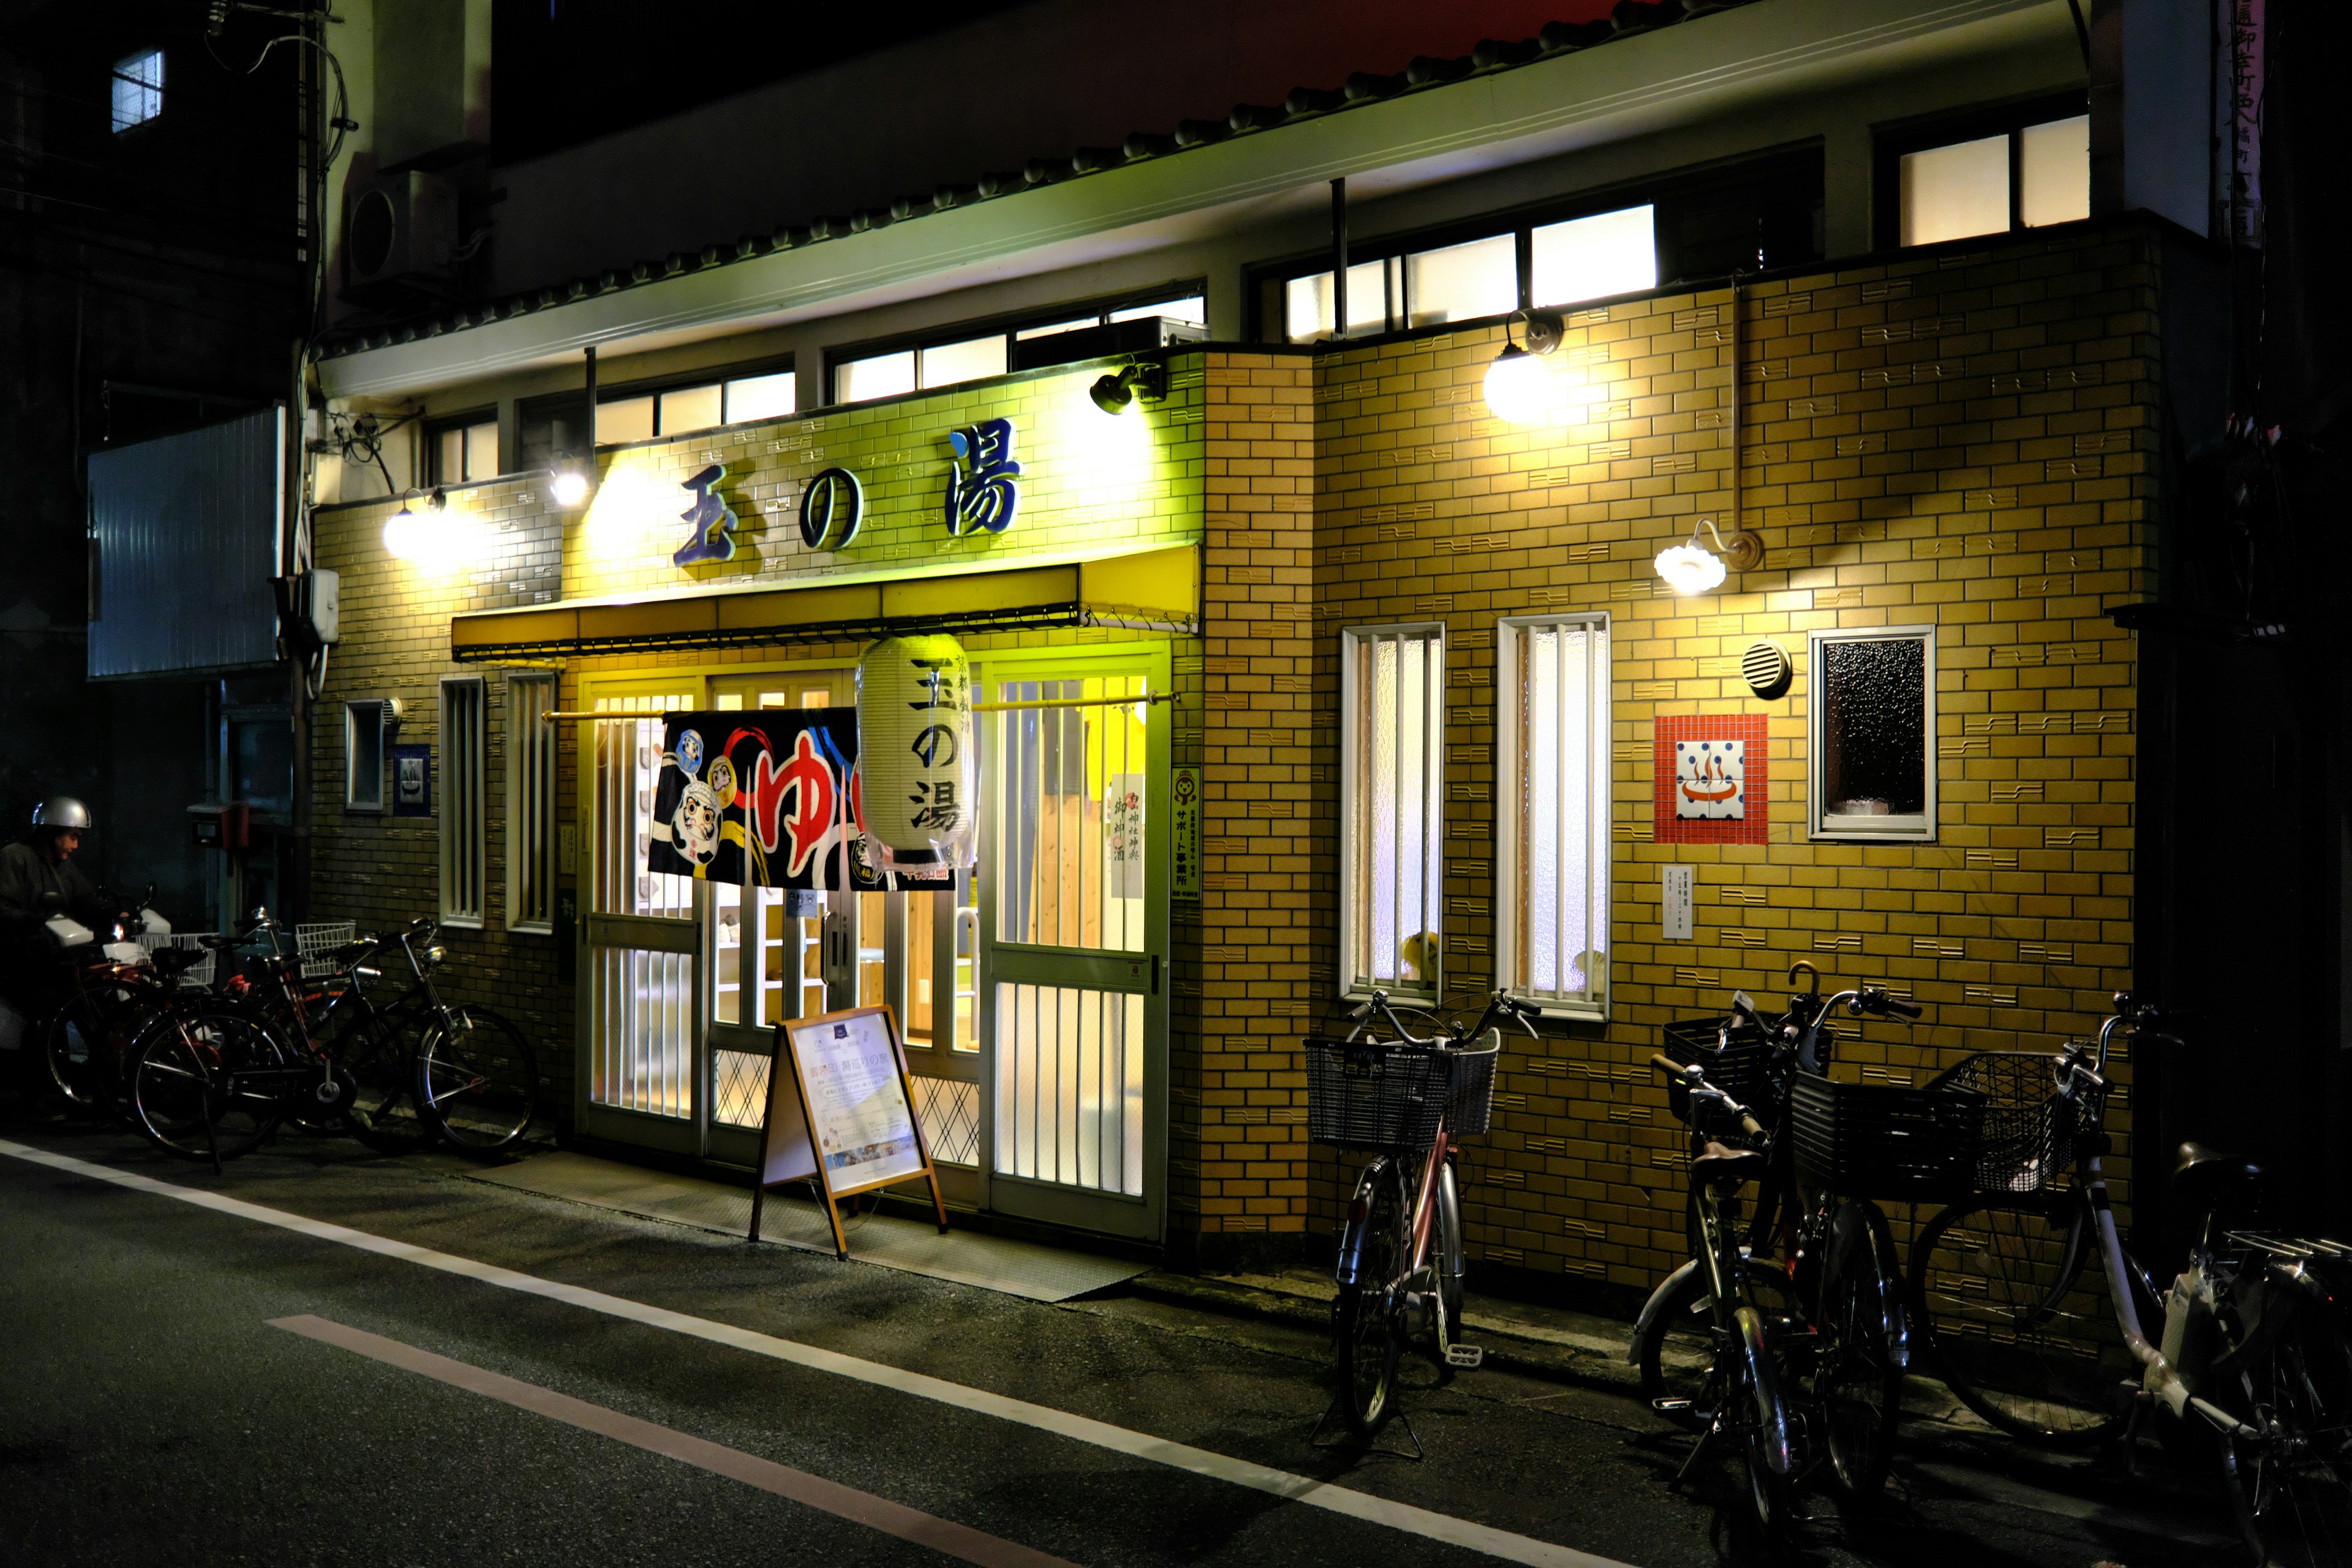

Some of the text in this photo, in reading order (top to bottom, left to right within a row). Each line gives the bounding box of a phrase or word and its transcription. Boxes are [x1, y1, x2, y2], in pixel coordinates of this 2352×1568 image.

[673, 418, 1025, 568] 玉の湯
[755, 729, 837, 877] ゆ
[908, 659, 962, 832] 玉の湯
[1176, 810, 1187, 886] サポート事業所
